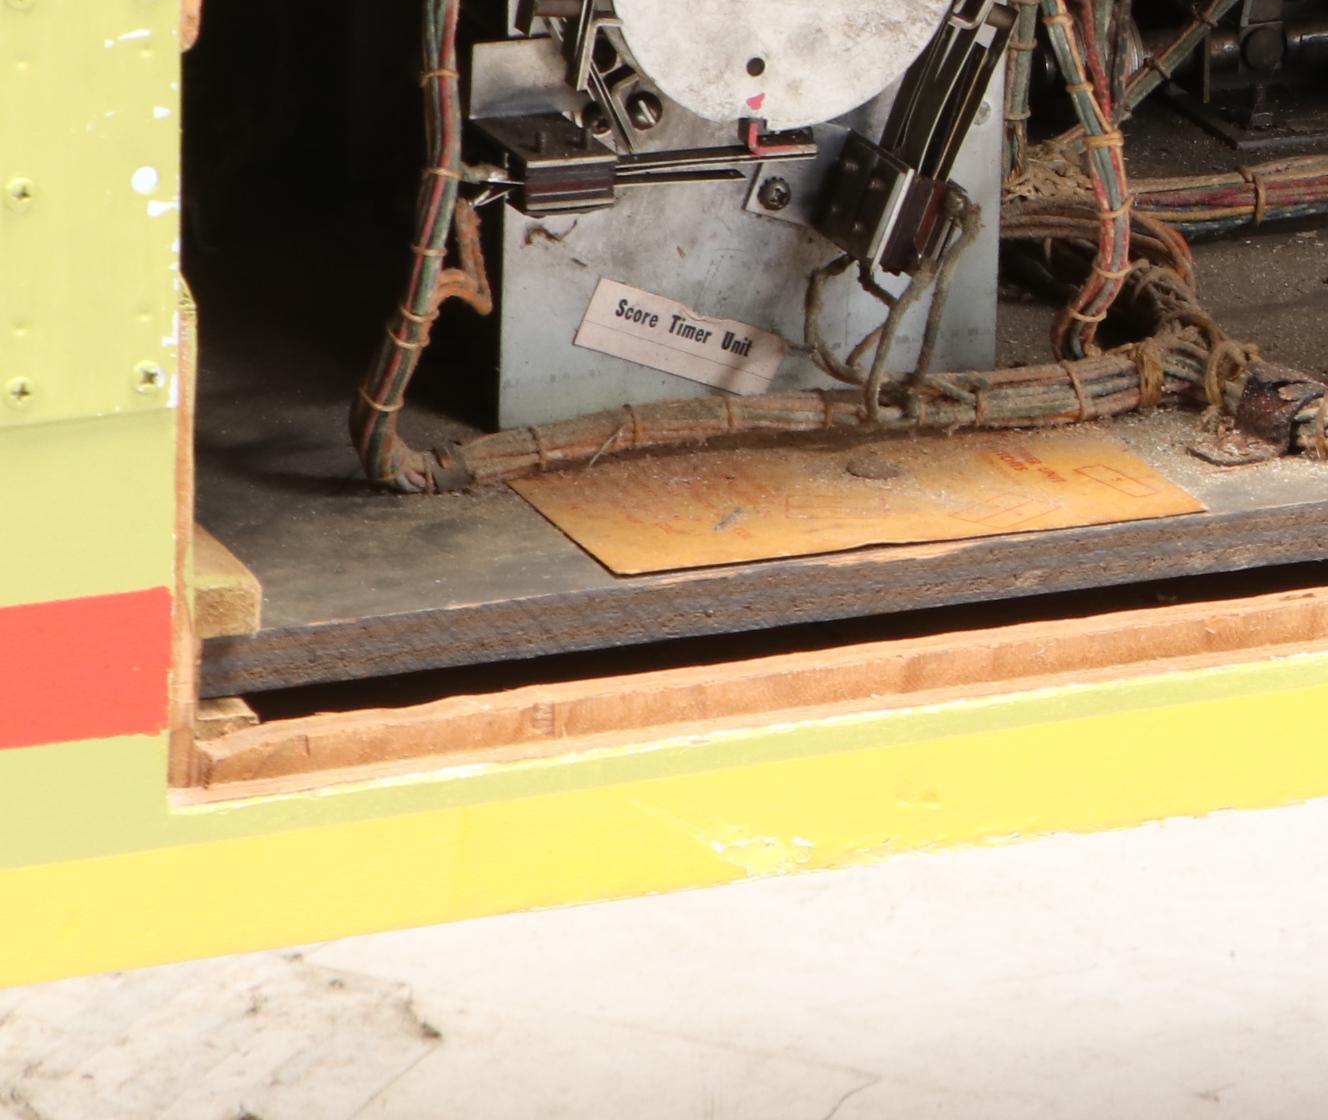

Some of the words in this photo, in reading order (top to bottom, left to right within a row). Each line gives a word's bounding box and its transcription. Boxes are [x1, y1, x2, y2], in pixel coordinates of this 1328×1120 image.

[615, 299, 659, 328] Score
[669, 314, 713, 344] Timer
[721, 331, 753, 357] Unit
